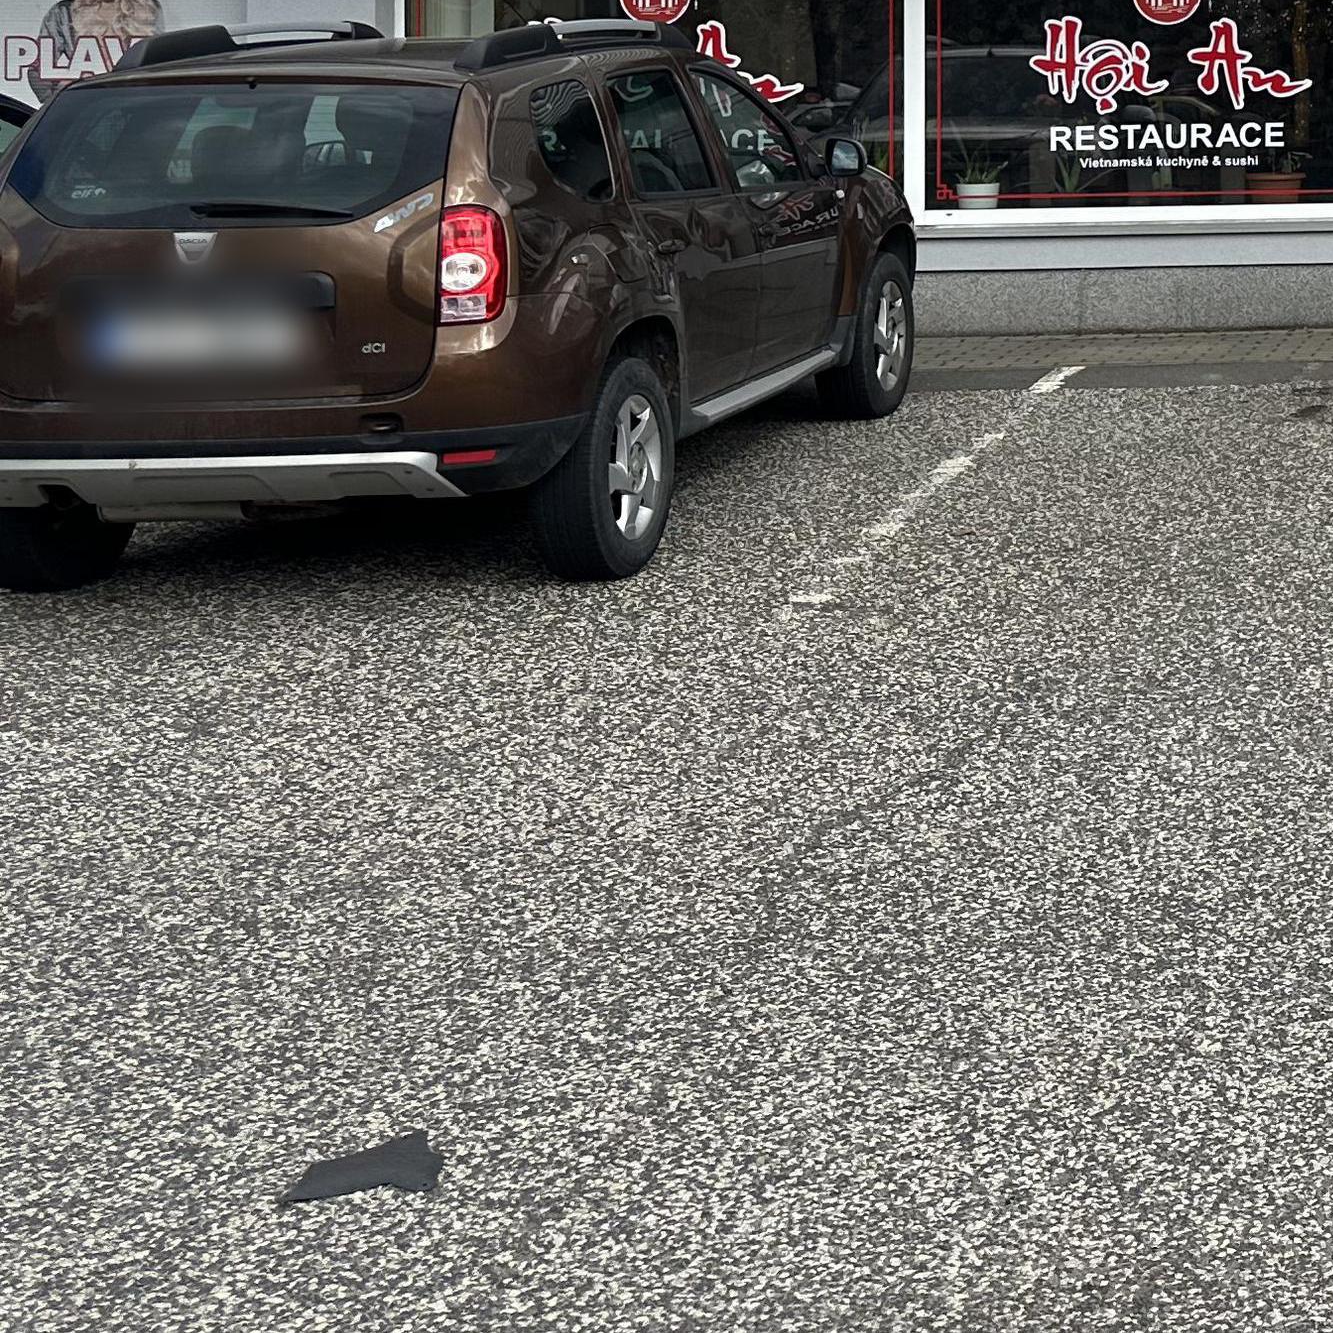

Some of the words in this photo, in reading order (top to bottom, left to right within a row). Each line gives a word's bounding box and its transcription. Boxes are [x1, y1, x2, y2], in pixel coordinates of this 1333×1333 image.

[1187, 17, 1313, 110] An
[1050, 122, 1285, 152] RESTAURACE
[1079, 156, 1153, 168] Vietnamská
[1156, 155, 1209, 170] kuchyně
[1212, 156, 1221, 167] &
[1224, 155, 1259, 167] sushi
